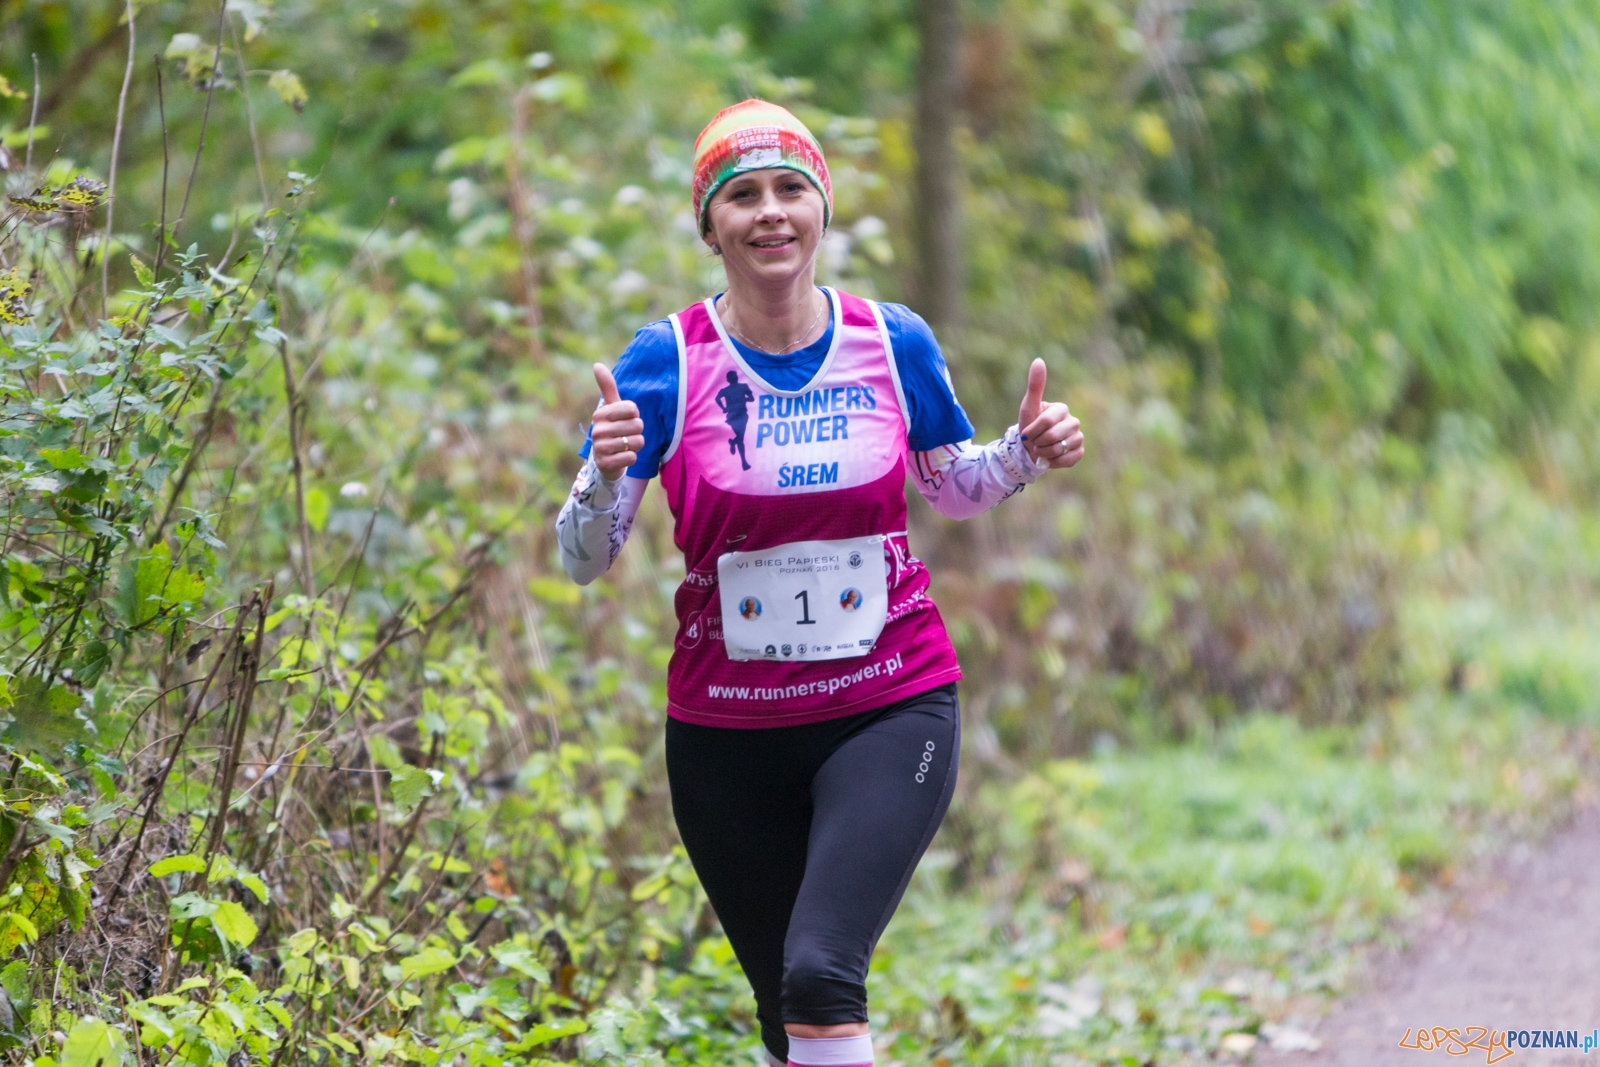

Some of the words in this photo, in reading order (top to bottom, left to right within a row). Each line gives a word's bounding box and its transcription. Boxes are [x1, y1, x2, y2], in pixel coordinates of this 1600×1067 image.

[737, 127, 779, 138] FESTIWAL
[756, 415, 848, 448] POWER
[777, 461, 839, 488] ŚREM
[736, 561, 749, 569] VI
[754, 559, 783, 568] BIEG
[787, 555, 840, 566] PAPIESKI
[816, 564, 840, 573] 2016
[794, 590, 816, 625] 1
[708, 652, 904, 701] www.runnerspower.pl
